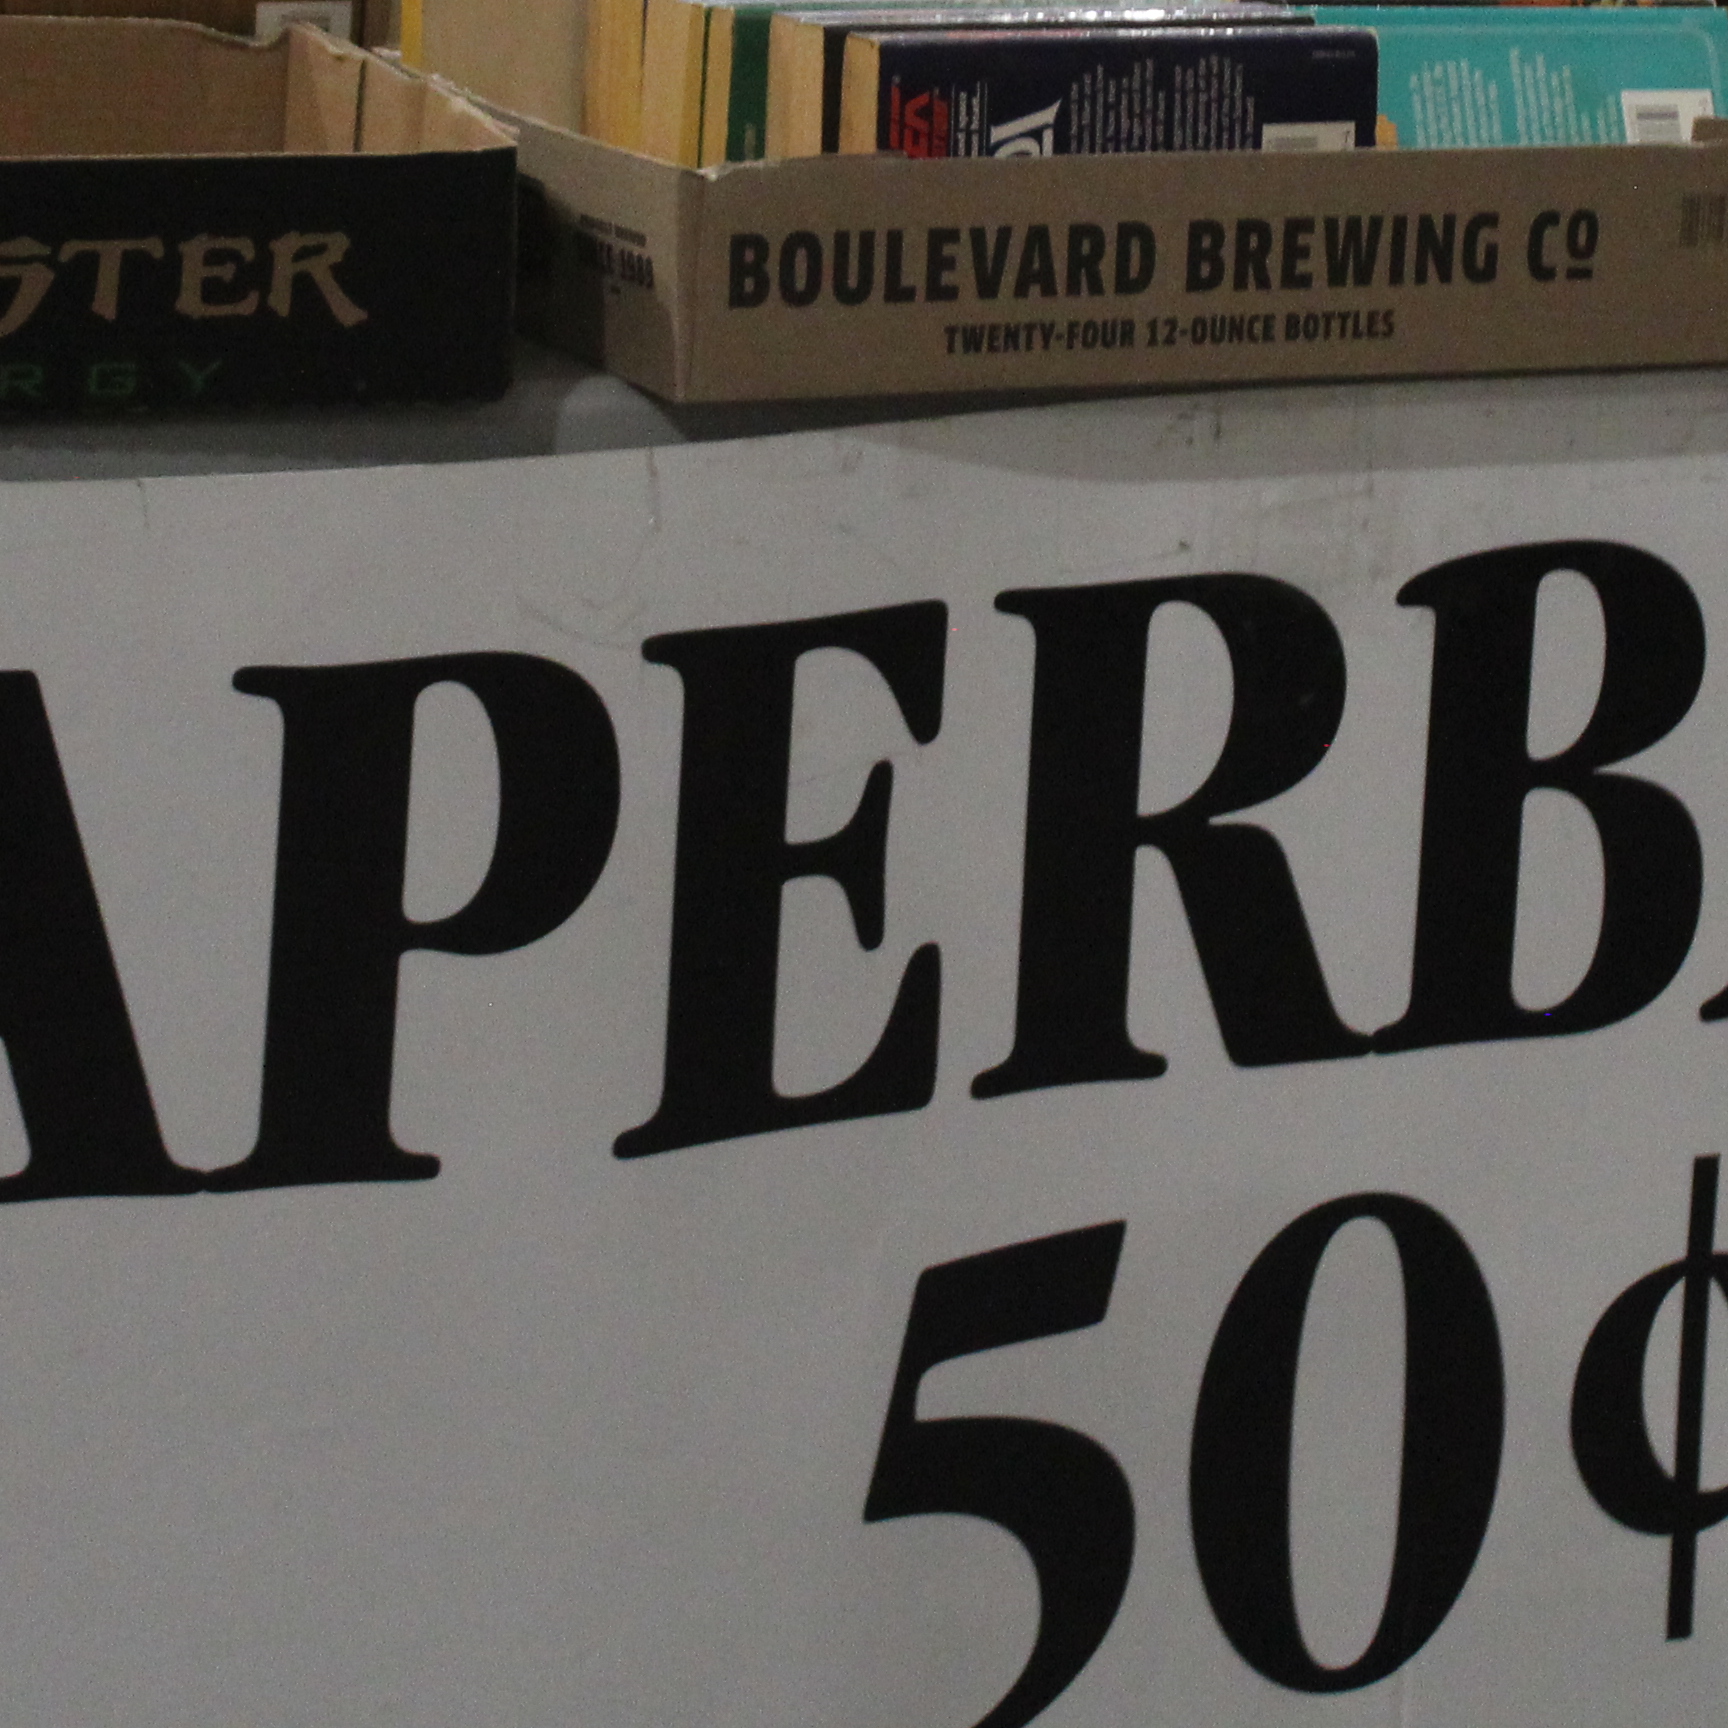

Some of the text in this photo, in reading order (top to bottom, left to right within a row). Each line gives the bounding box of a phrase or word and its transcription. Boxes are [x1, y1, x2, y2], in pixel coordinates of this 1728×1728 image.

[728, 219, 1156, 309] BOULEVARD
[1184, 211, 1501, 295] BREWING
[943, 307, 1396, 354] TWENTY-FOUR 12-OUNCE BOTTLES
